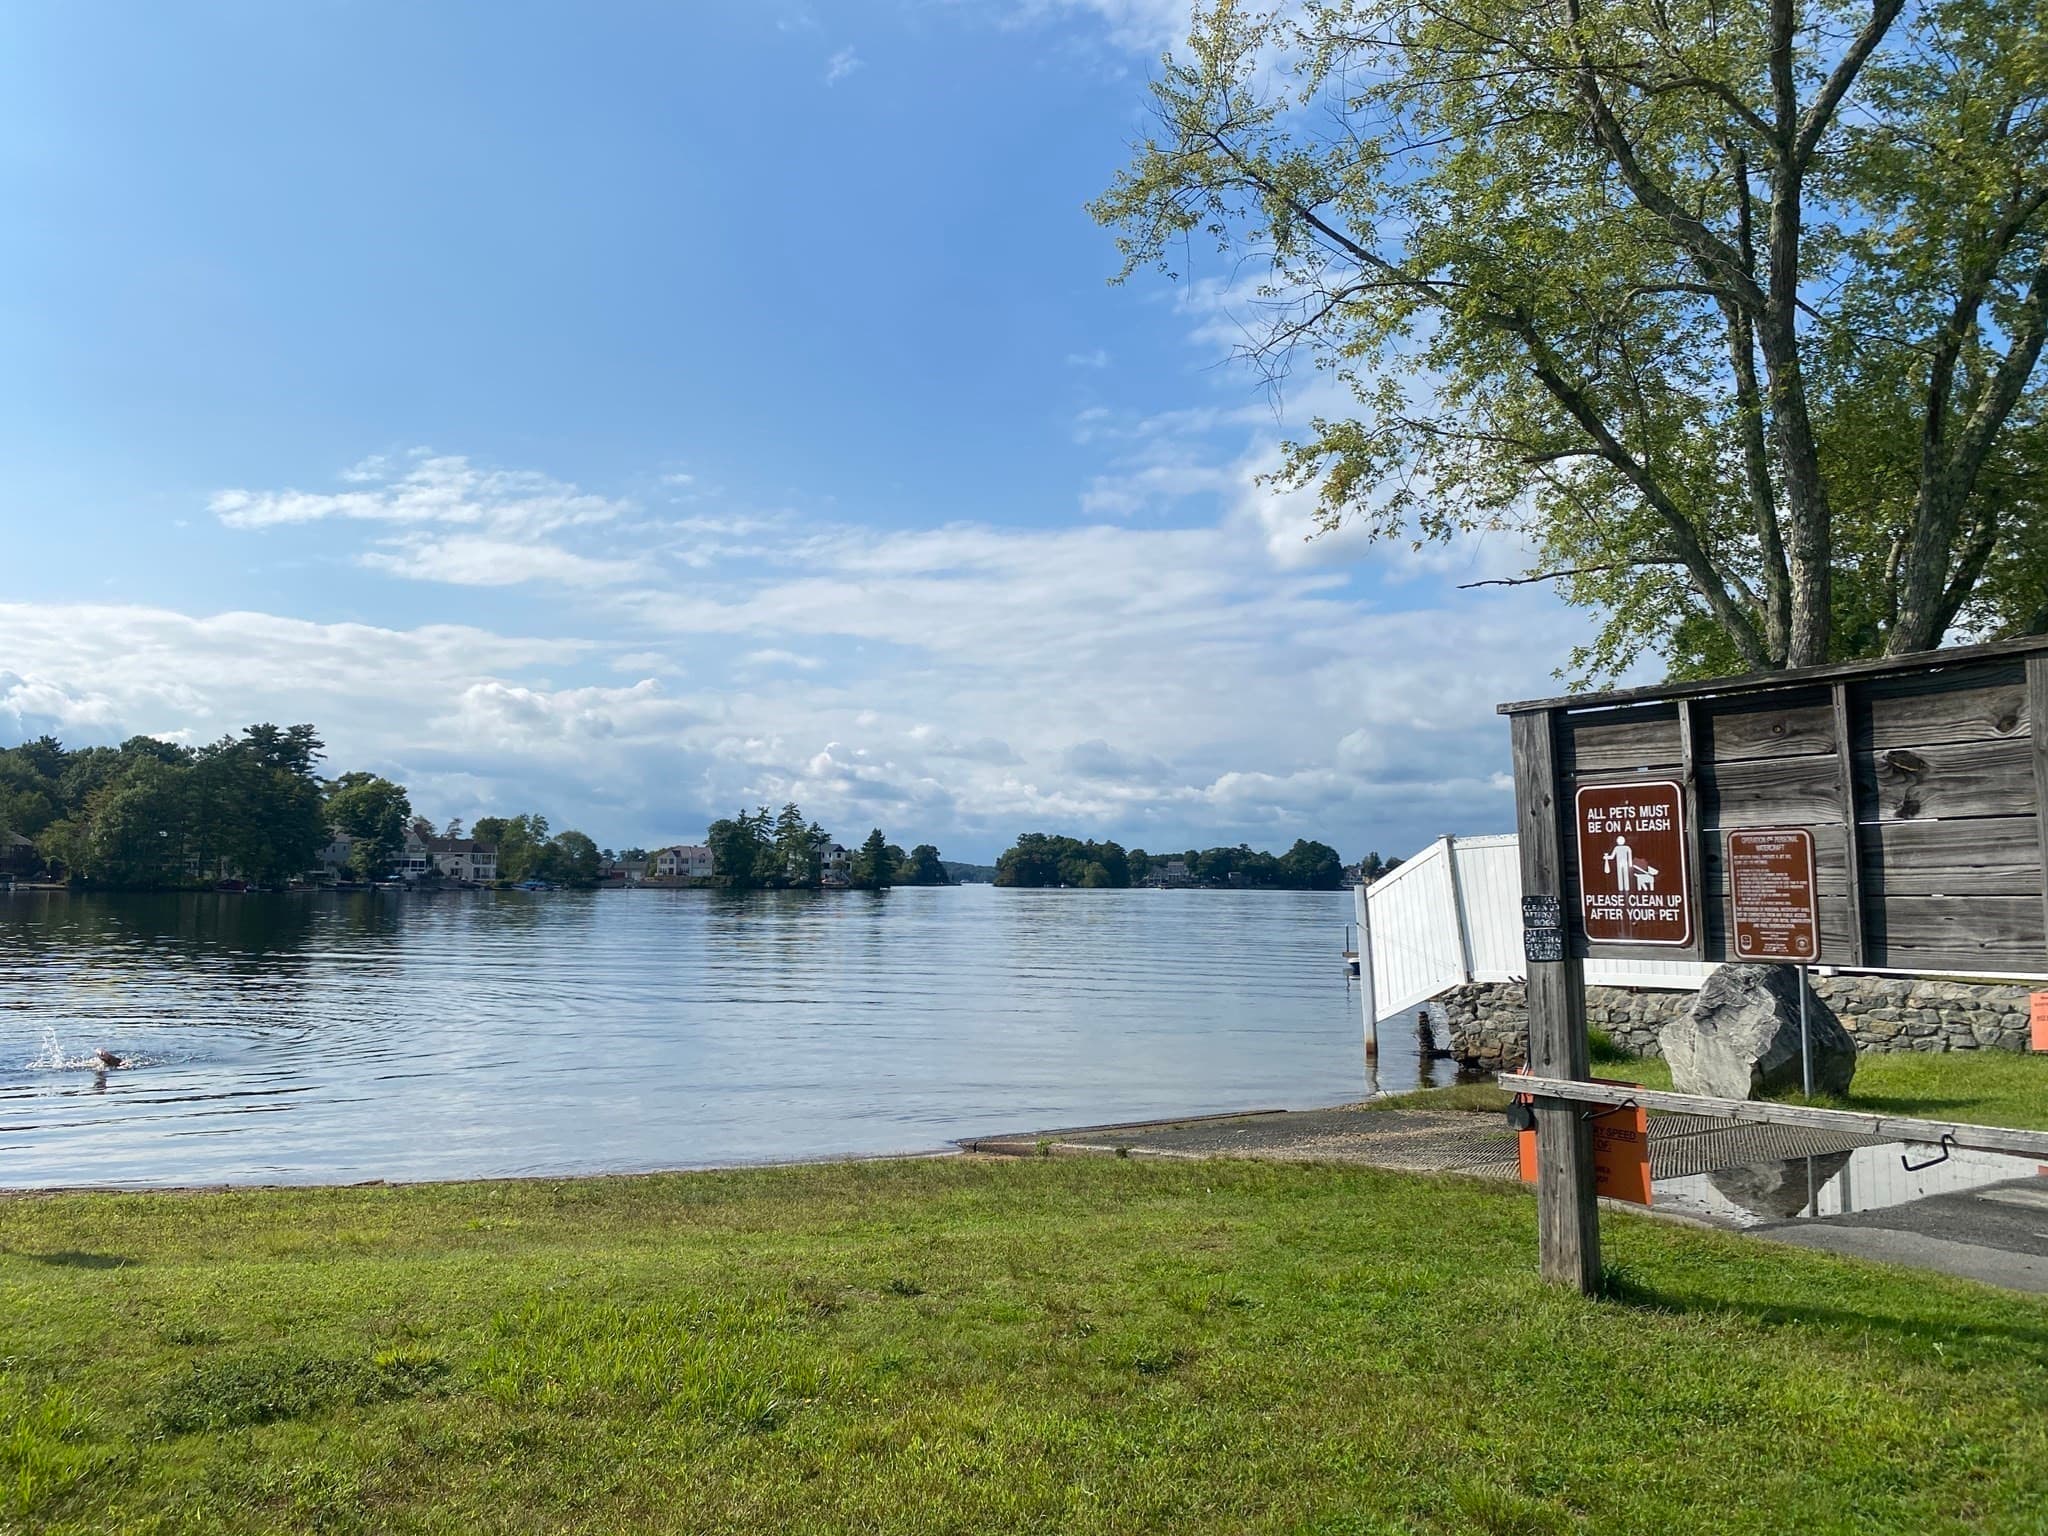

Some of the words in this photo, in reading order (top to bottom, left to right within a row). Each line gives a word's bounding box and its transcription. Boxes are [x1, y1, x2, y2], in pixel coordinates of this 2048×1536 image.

[1587, 808, 1606, 820] ALL
[1609, 806, 1636, 819] PETS
[1639, 804, 1670, 818] MUST
[1588, 821, 1602, 833] BE
[1605, 820, 1621, 833] ON
[1624, 820, 1633, 832] A
[1635, 818, 1671, 832] LEASH
[1586, 894, 1625, 907] PLEASE
[1628, 894, 1664, 907] CLEAN
[1667, 894, 1682, 907] UP
[1590, 908, 1623, 920] AFTER
[1627, 908, 1656, 921] YOUR
[1659, 908, 1680, 921] PET
[1606, 1127, 1637, 1140] SPEED
